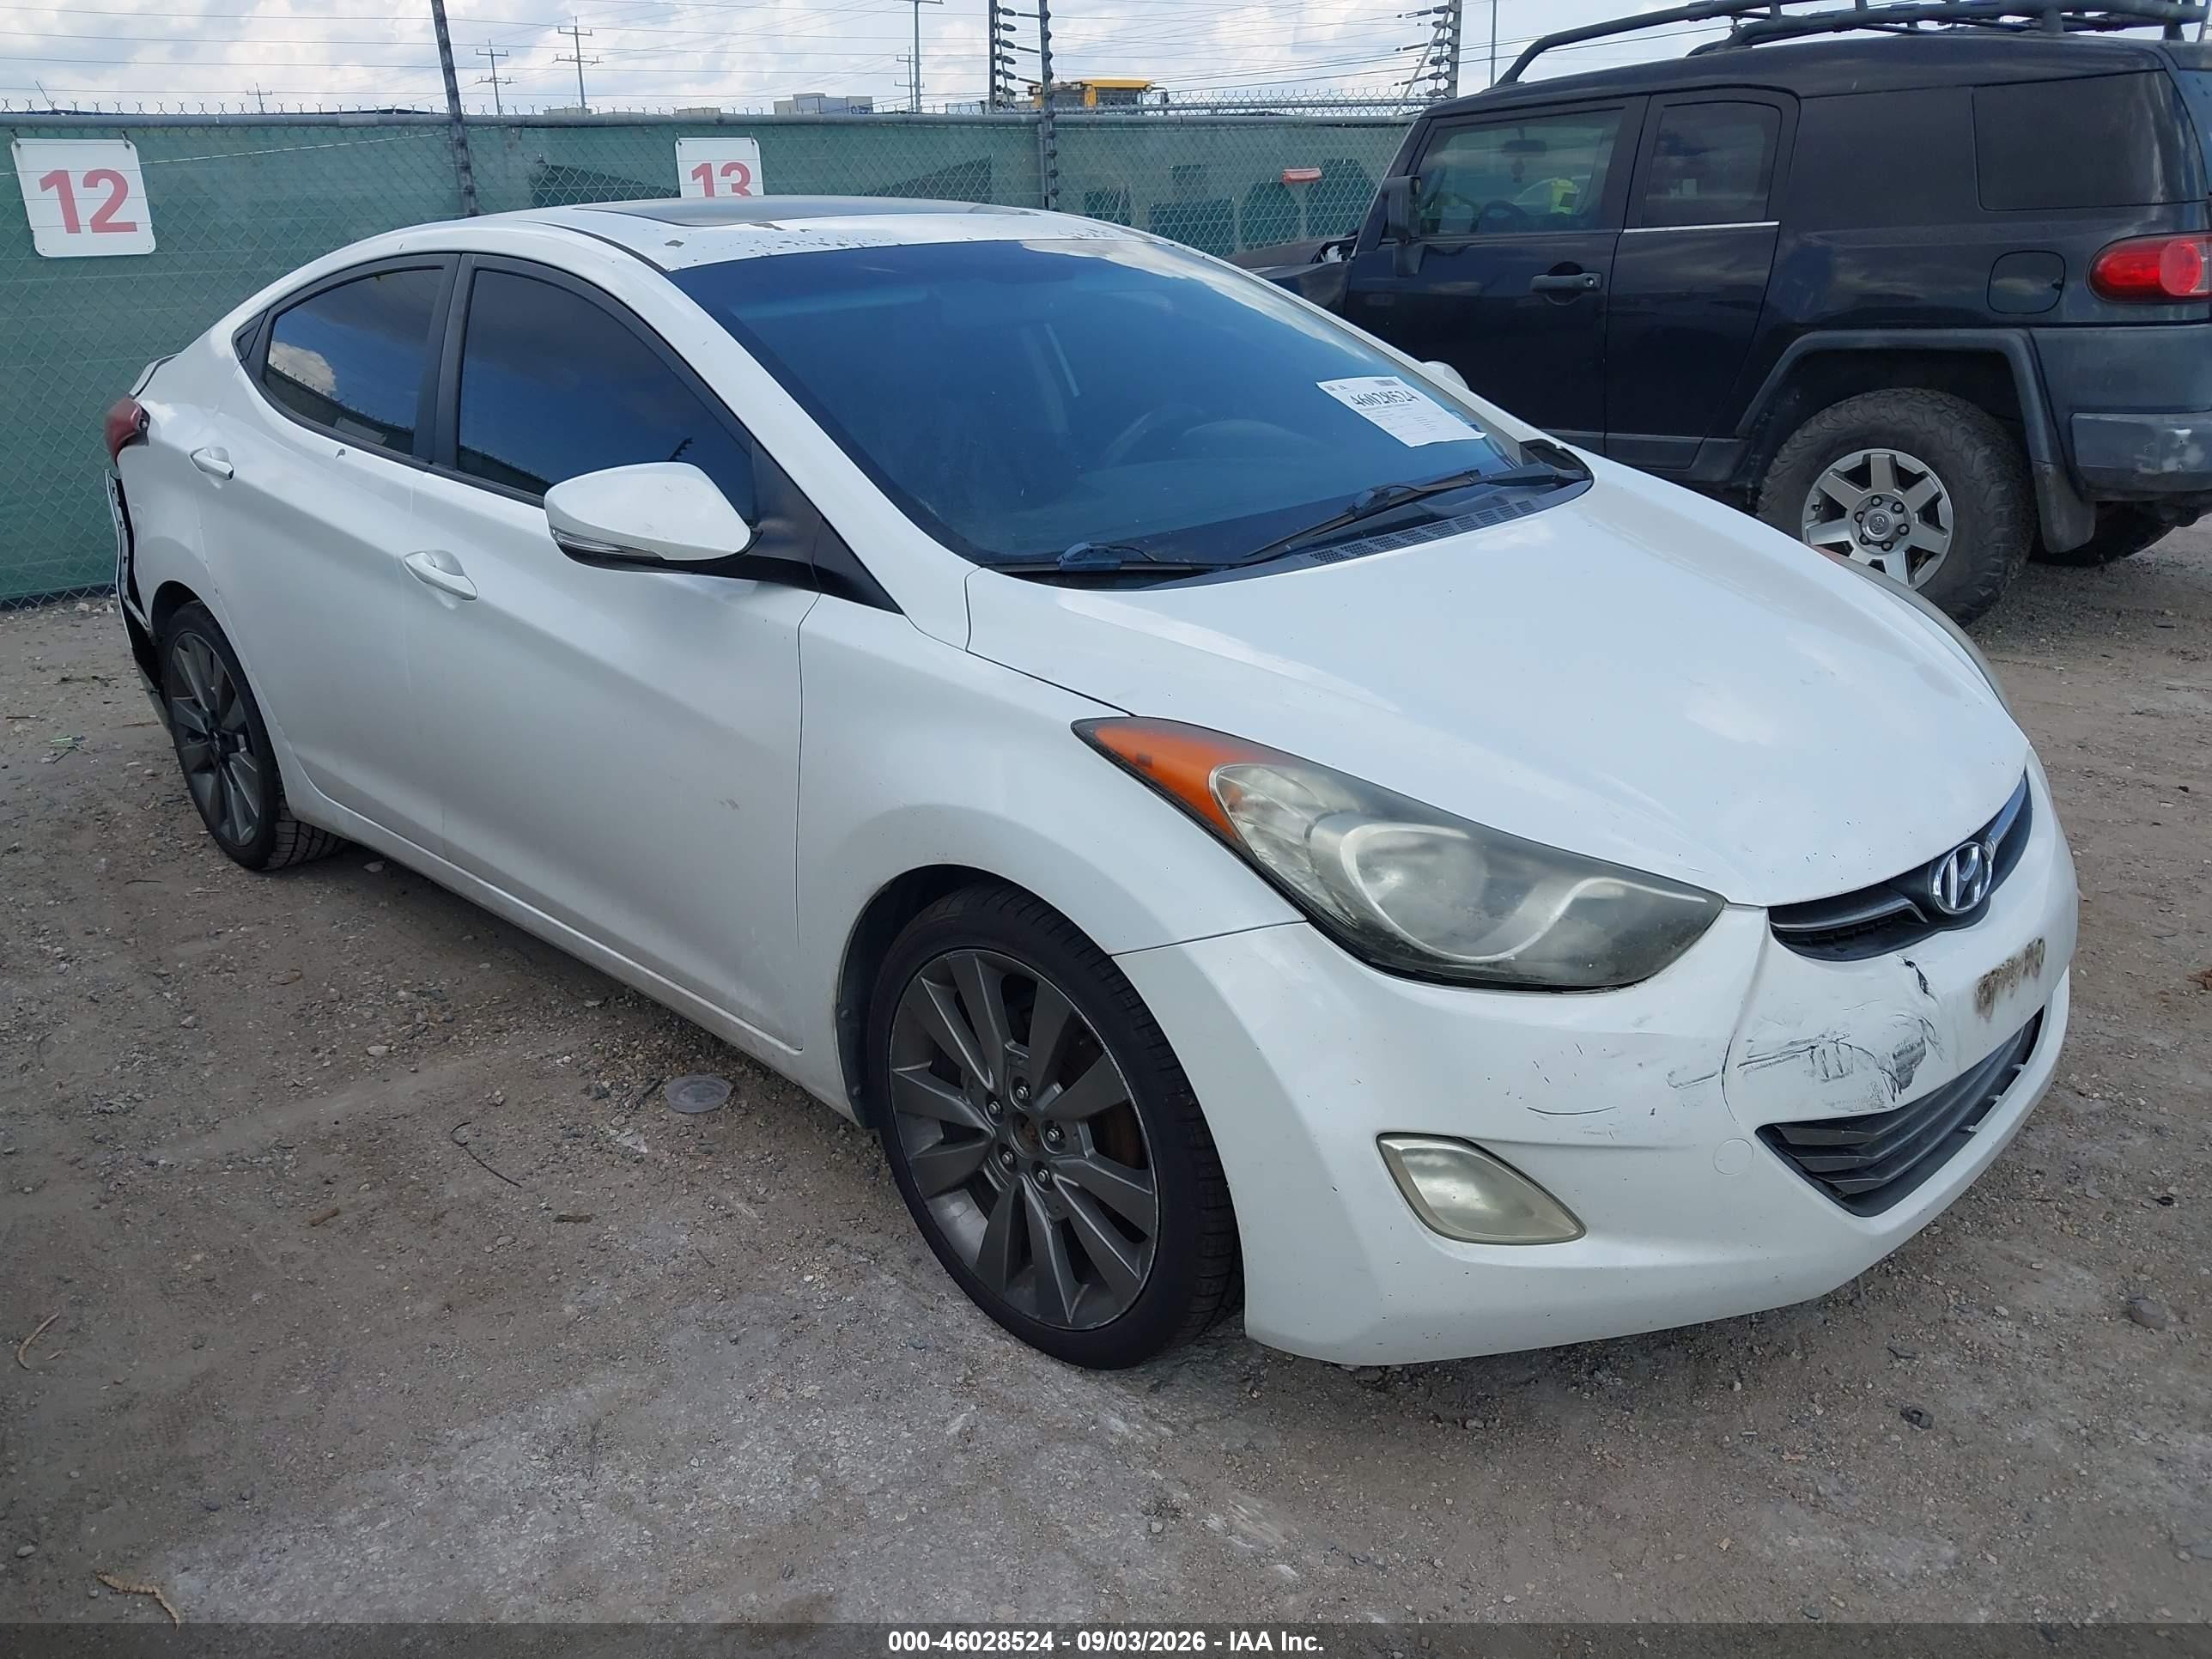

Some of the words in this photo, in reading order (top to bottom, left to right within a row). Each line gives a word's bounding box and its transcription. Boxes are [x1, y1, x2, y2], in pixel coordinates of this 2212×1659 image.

[691, 161, 752, 198] 13
[39, 168, 137, 234] 12
[1350, 390, 1419, 406] 46028524
